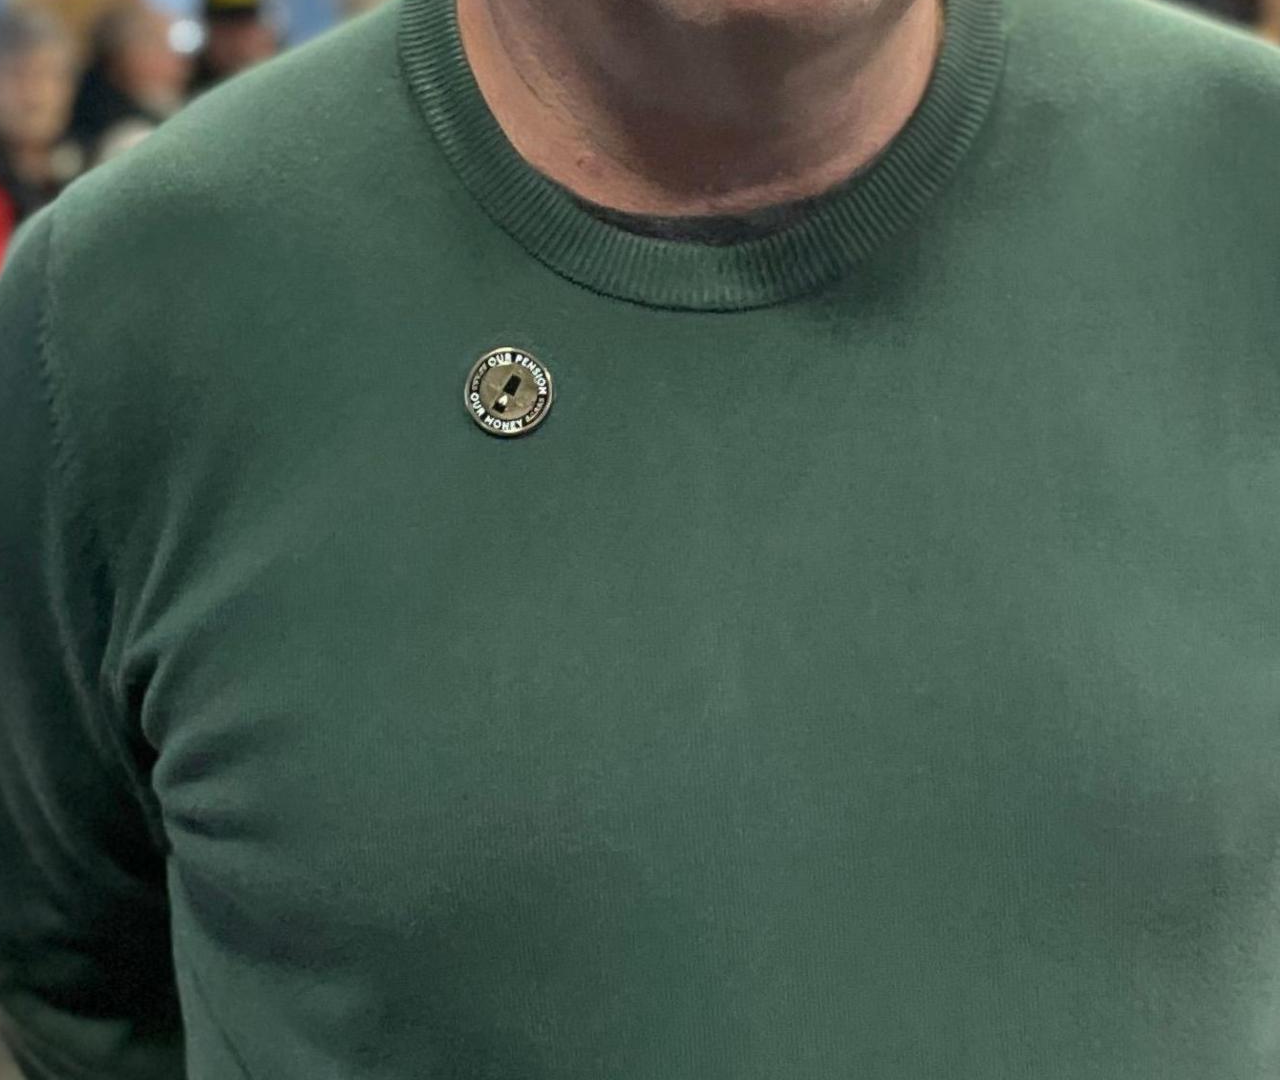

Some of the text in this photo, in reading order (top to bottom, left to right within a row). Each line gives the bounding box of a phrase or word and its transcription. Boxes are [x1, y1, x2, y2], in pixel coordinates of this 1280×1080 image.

[488, 353, 512, 367] OUR
[515, 354, 547, 395] PENSION
[470, 392, 523, 431] OUR MONEY
